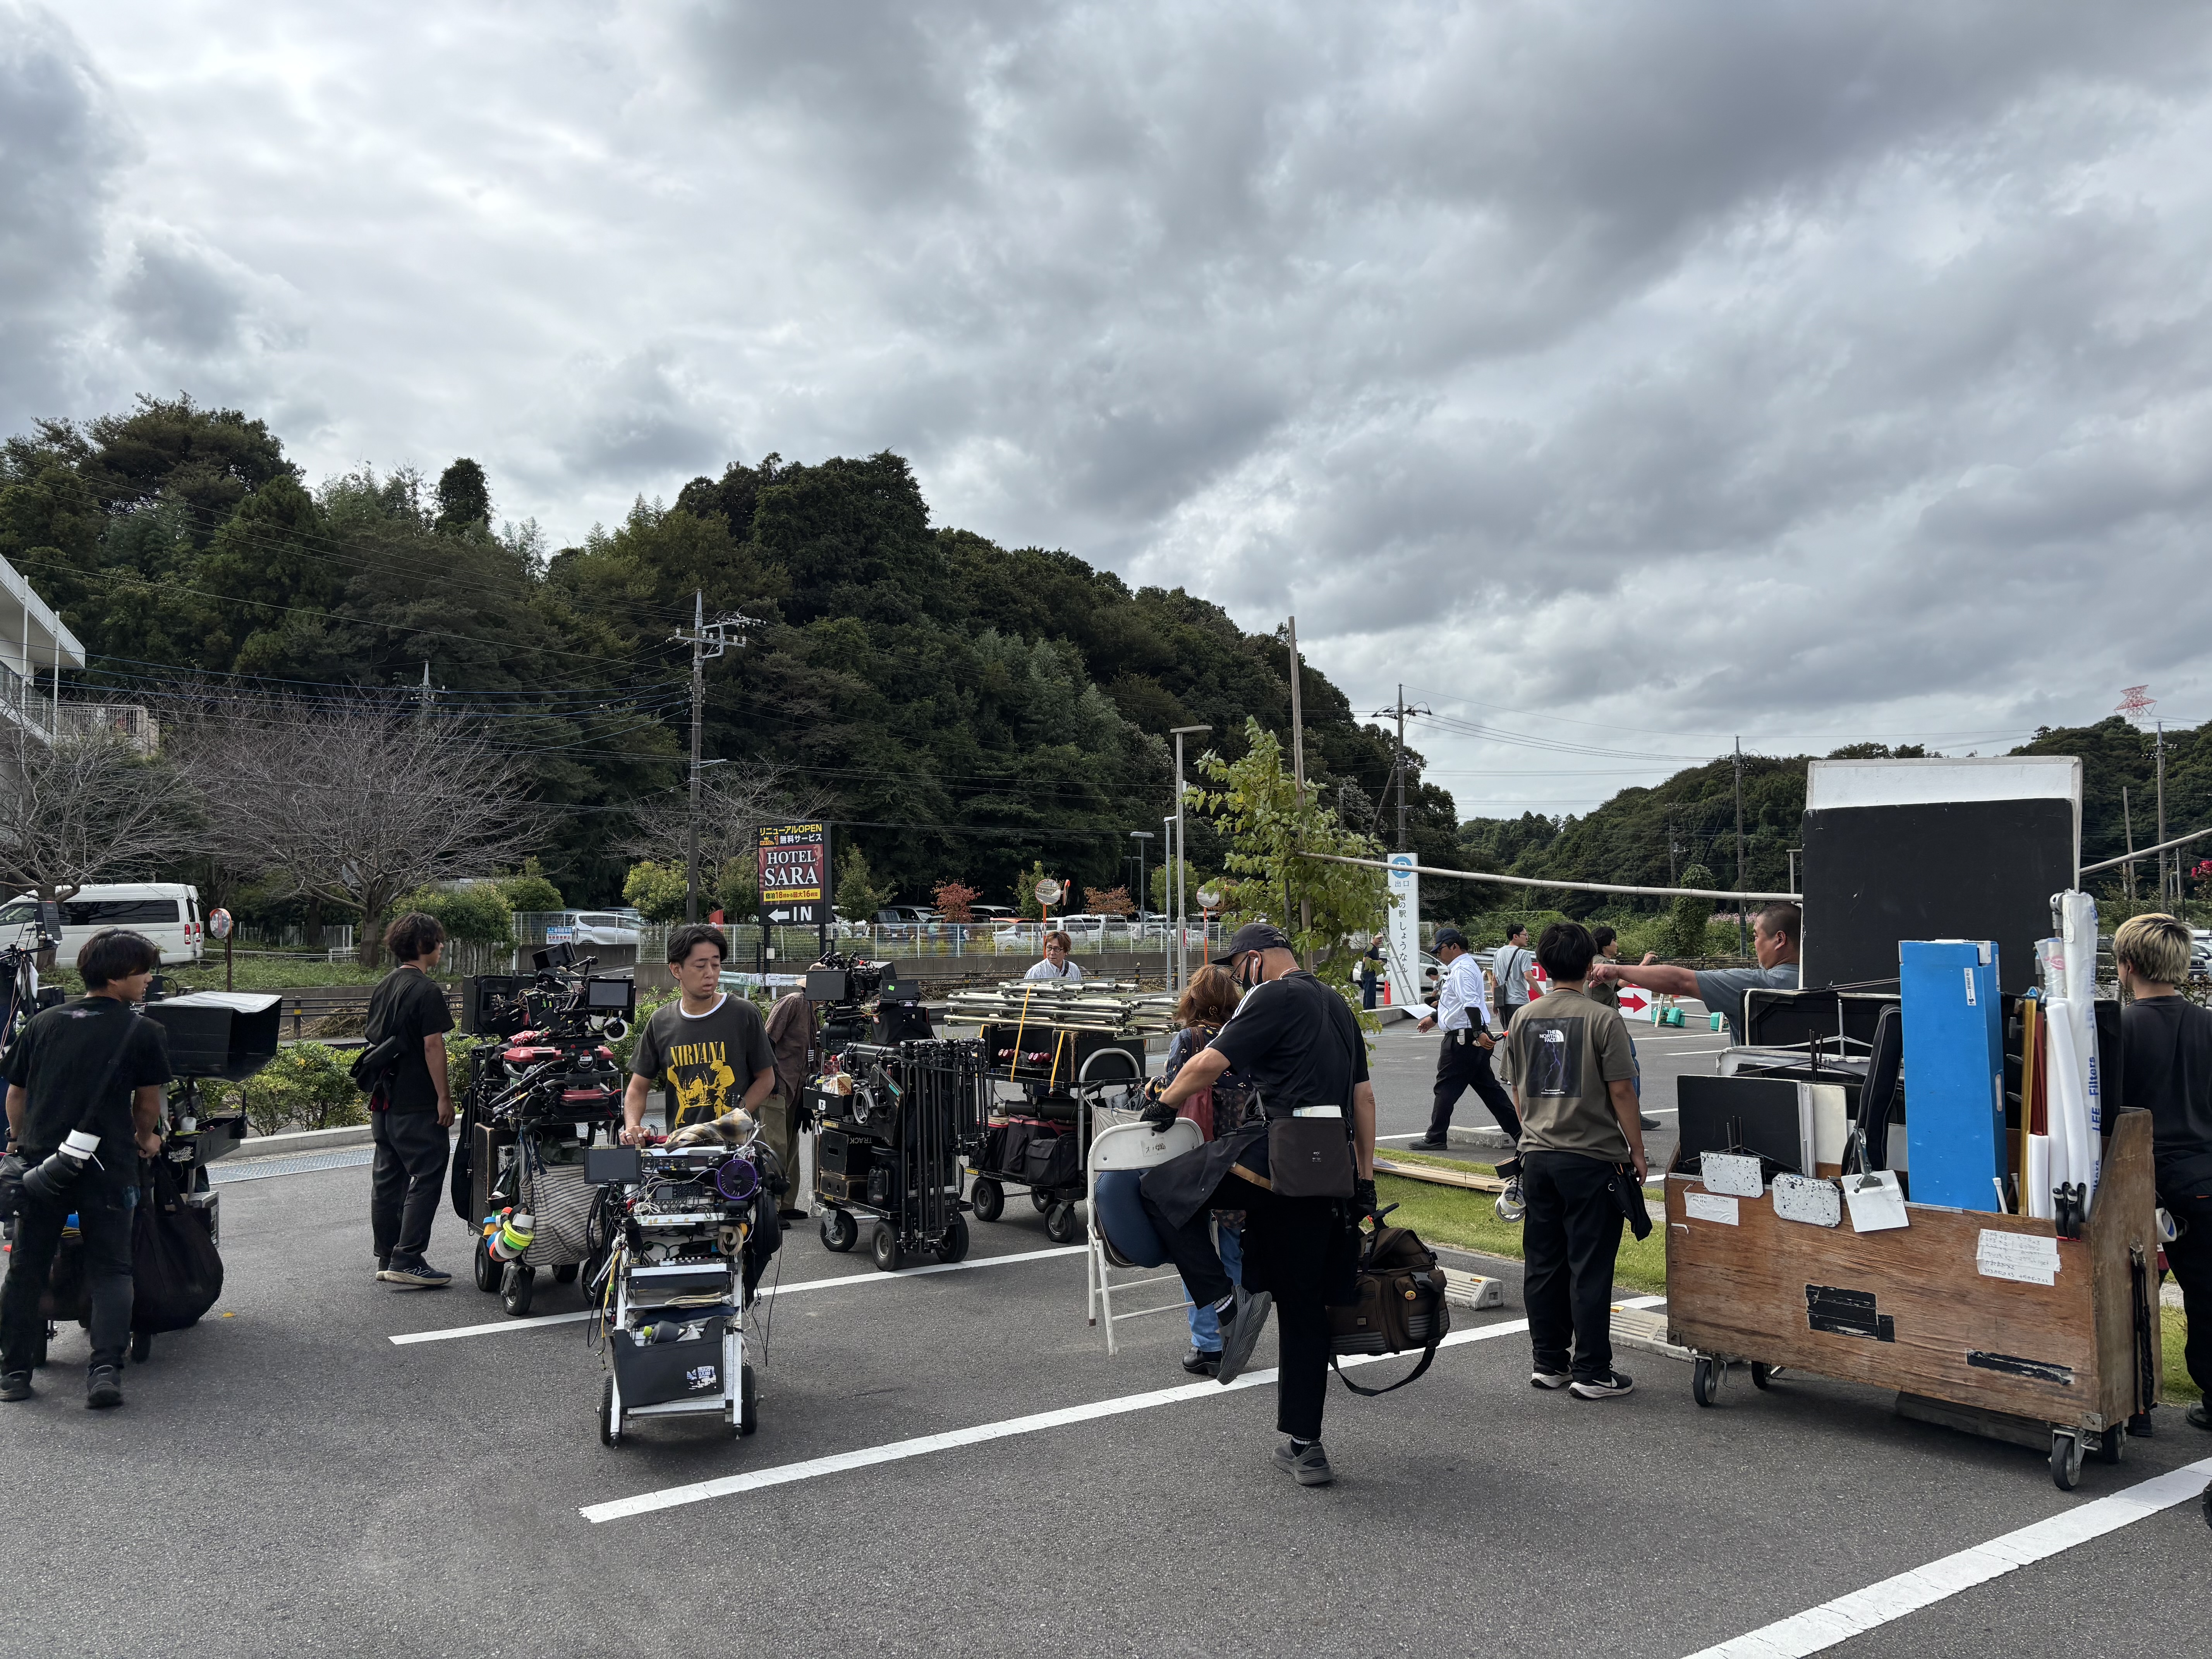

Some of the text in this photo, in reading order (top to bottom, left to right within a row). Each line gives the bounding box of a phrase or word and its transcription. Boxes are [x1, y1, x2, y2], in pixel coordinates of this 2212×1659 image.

[760, 824, 822, 836] リニューアルOPEN
[780, 834, 822, 844] 無料サービス
[767, 850, 816, 864] HOTEL
[765, 866, 819, 886] SARA
[793, 906, 812, 921] IN
[670, 1041, 726, 1067] NIRVANA
[2088, 1056, 2101, 1131] LEE Filters
